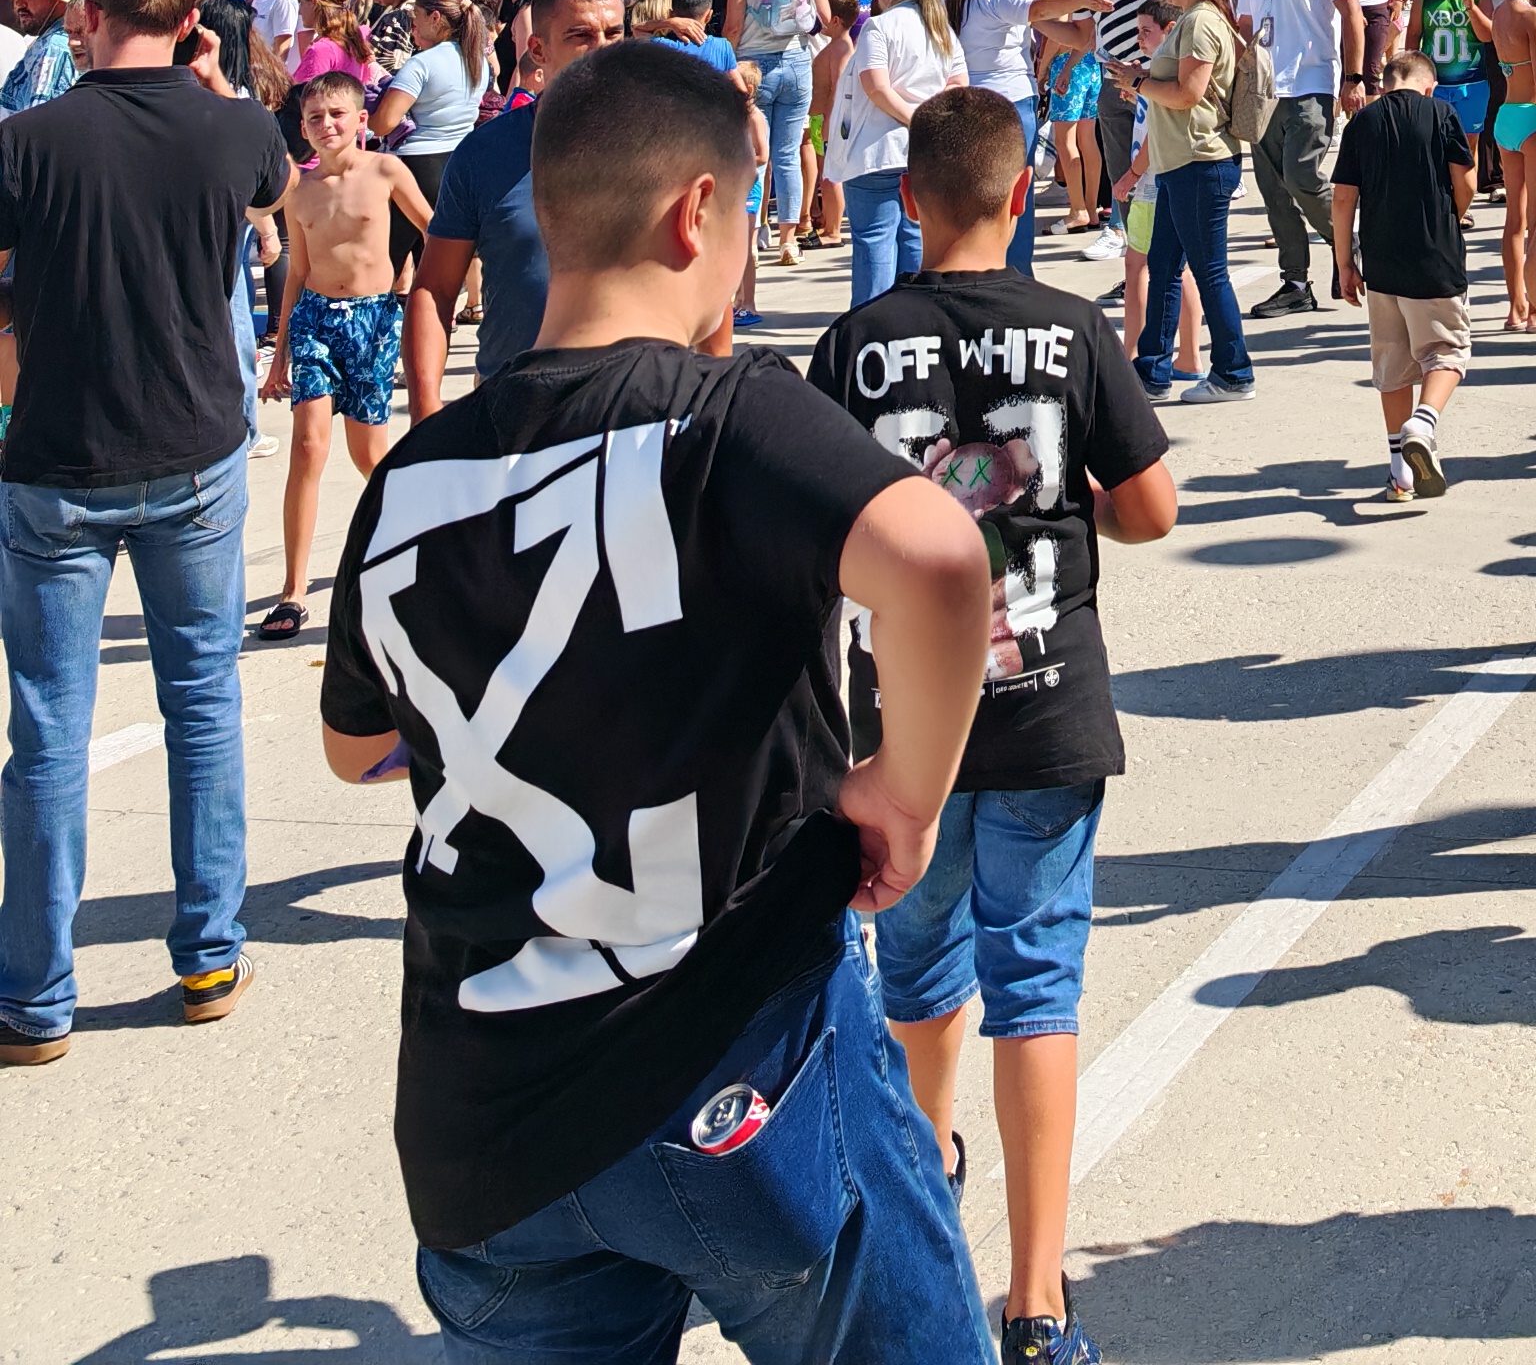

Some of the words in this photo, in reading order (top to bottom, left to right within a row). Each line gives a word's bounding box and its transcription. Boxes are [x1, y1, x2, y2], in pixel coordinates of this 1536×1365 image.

[1433, 29, 1472, 63] 01
[856, 336, 941, 399] OFF
[959, 324, 1074, 385] WHITE
